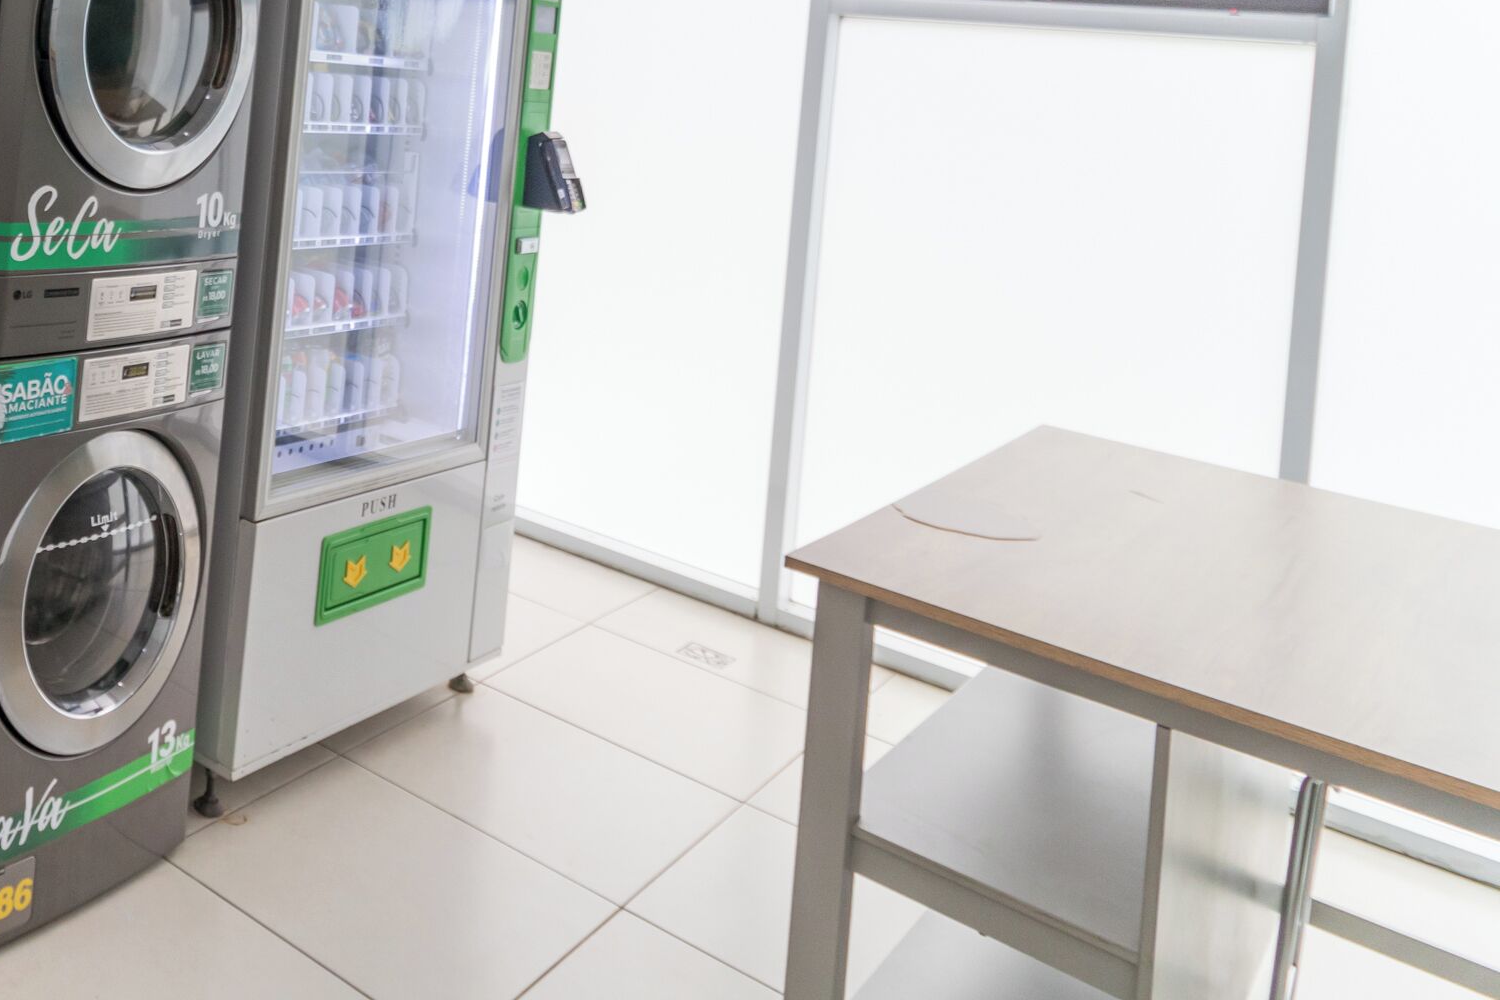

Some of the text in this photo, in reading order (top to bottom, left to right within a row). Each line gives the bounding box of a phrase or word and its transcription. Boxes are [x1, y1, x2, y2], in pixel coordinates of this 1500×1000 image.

[10, 185, 122, 262] SeCa
[1, 372, 68, 404] SABÃO
[361, 494, 397, 517] PUSH
[91, 511, 118, 528] Limit
